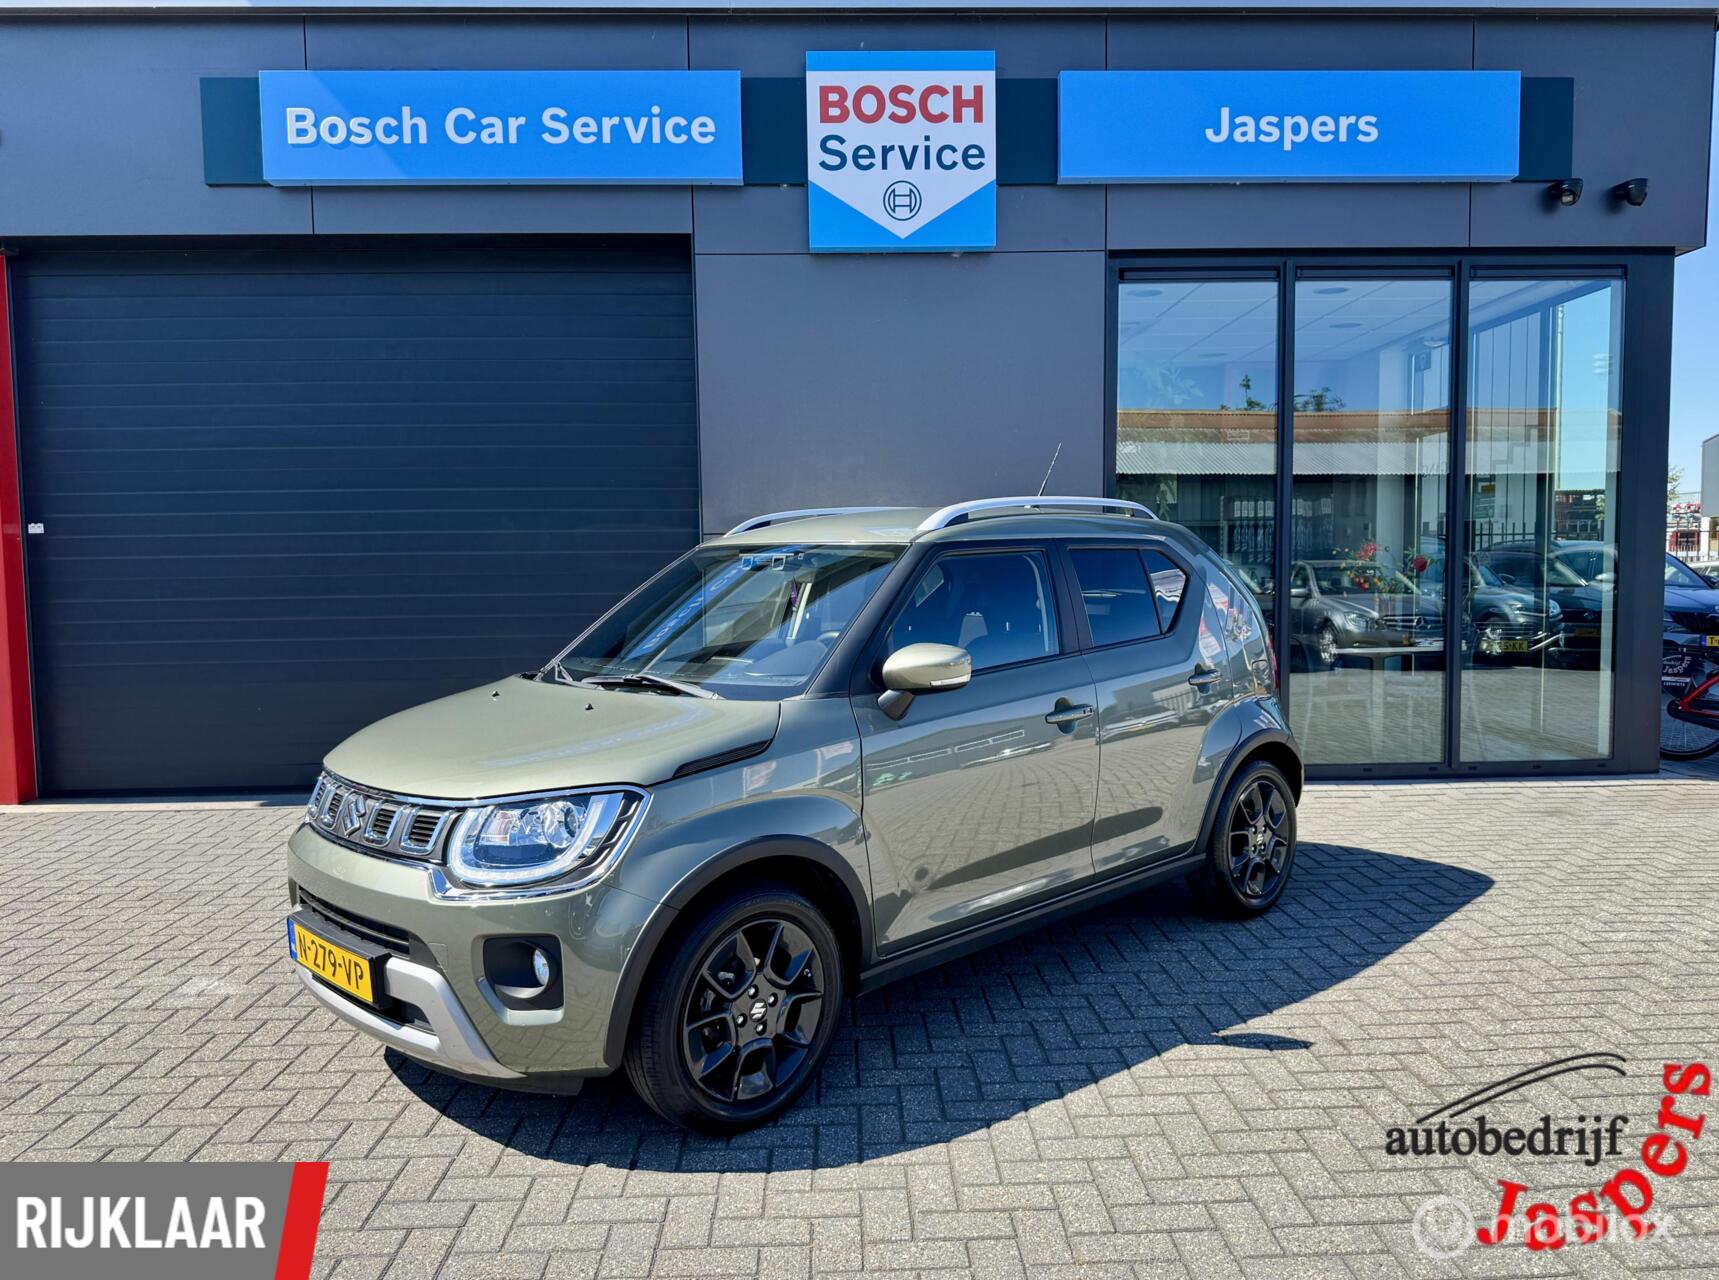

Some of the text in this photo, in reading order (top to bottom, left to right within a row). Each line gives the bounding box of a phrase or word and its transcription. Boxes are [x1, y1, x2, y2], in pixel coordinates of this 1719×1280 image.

[819, 84, 984, 124] BOSCH
[285, 105, 716, 145] Bosch Car Service
[1205, 107, 1379, 151] Jaspers
[818, 134, 986, 171] Service
[297, 930, 365, 991] N-279-VP
